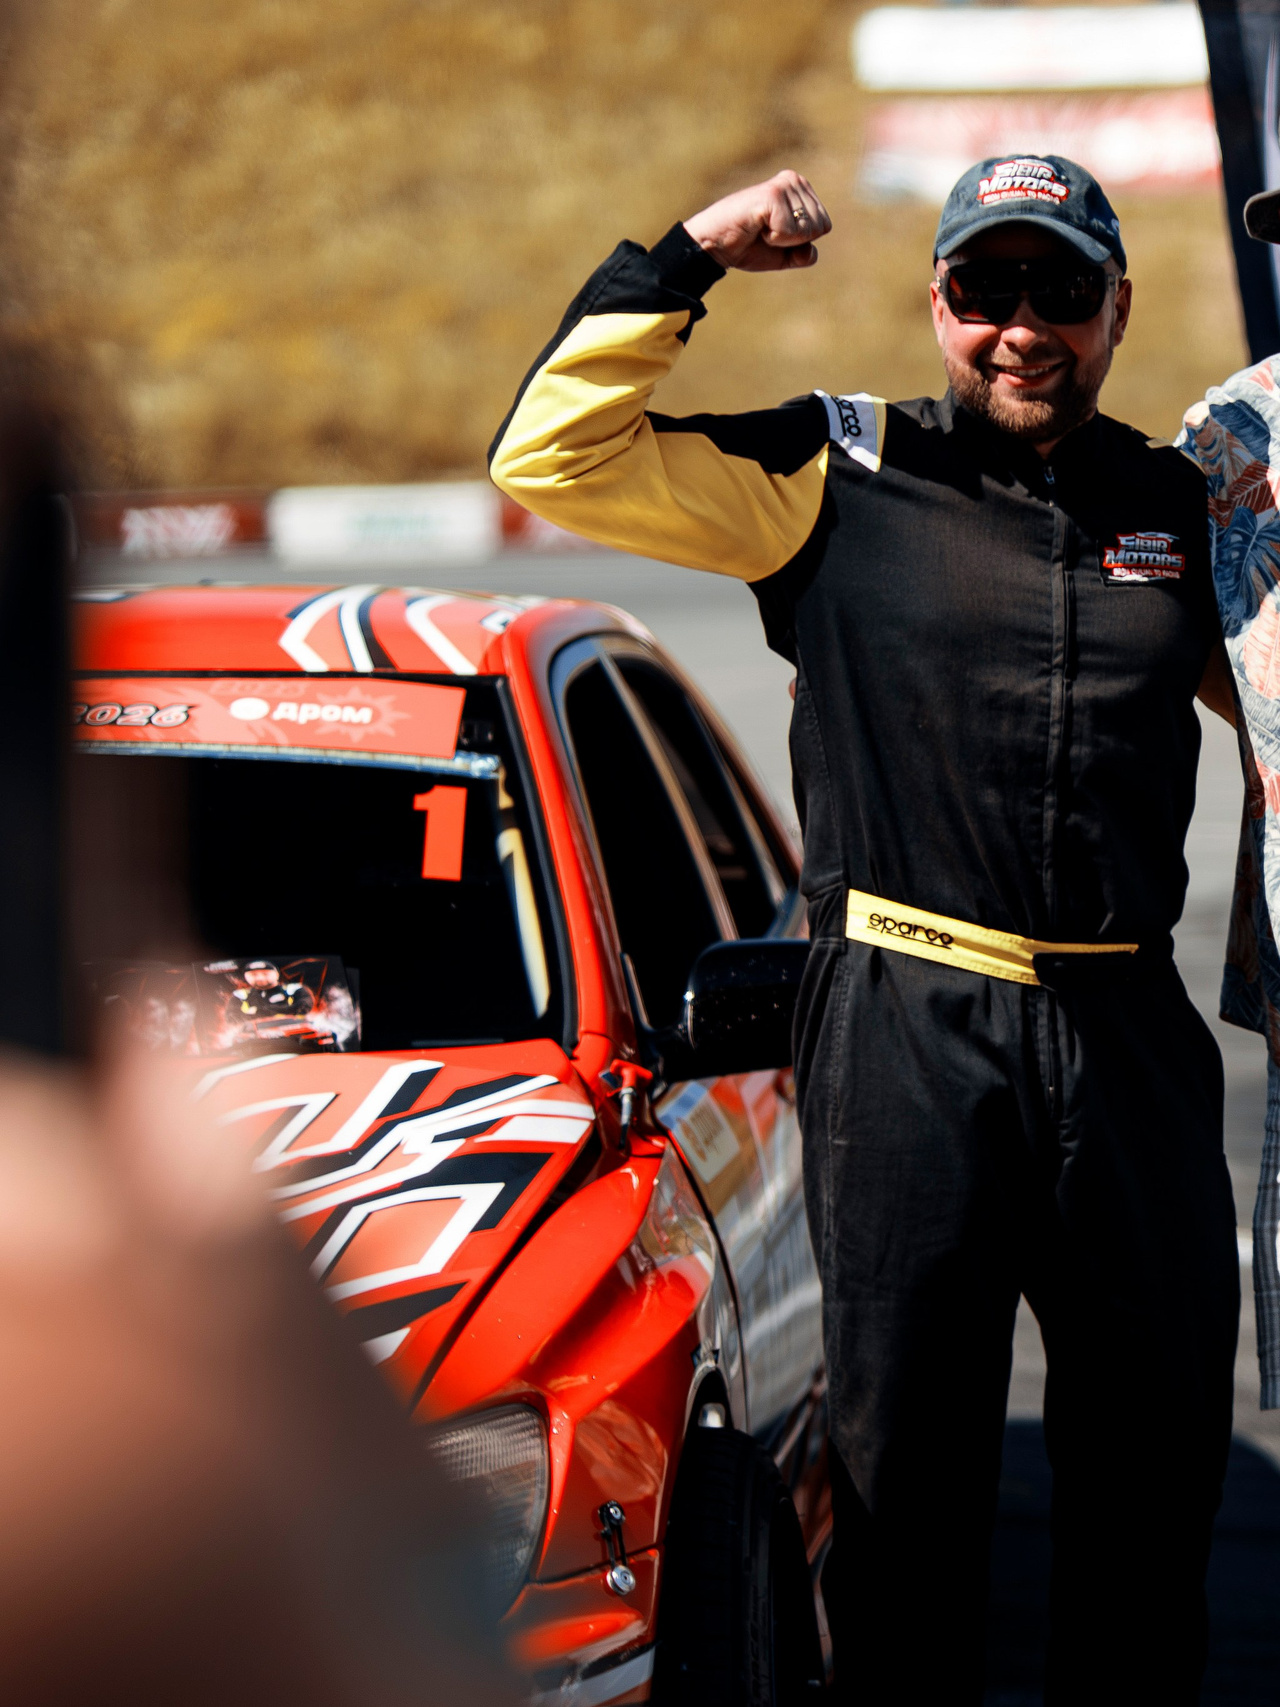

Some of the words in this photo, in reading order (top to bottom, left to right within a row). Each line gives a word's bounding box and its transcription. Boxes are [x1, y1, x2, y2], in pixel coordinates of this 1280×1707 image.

[995, 162, 1053, 179] SIBIR
[979, 175, 1067, 196] MOTORS
[1118, 536, 1168, 552] SIBIR
[1105, 549, 1183, 567] MOTORS
[413, 784, 468, 881] 1
[868, 912, 954, 946] sparco
